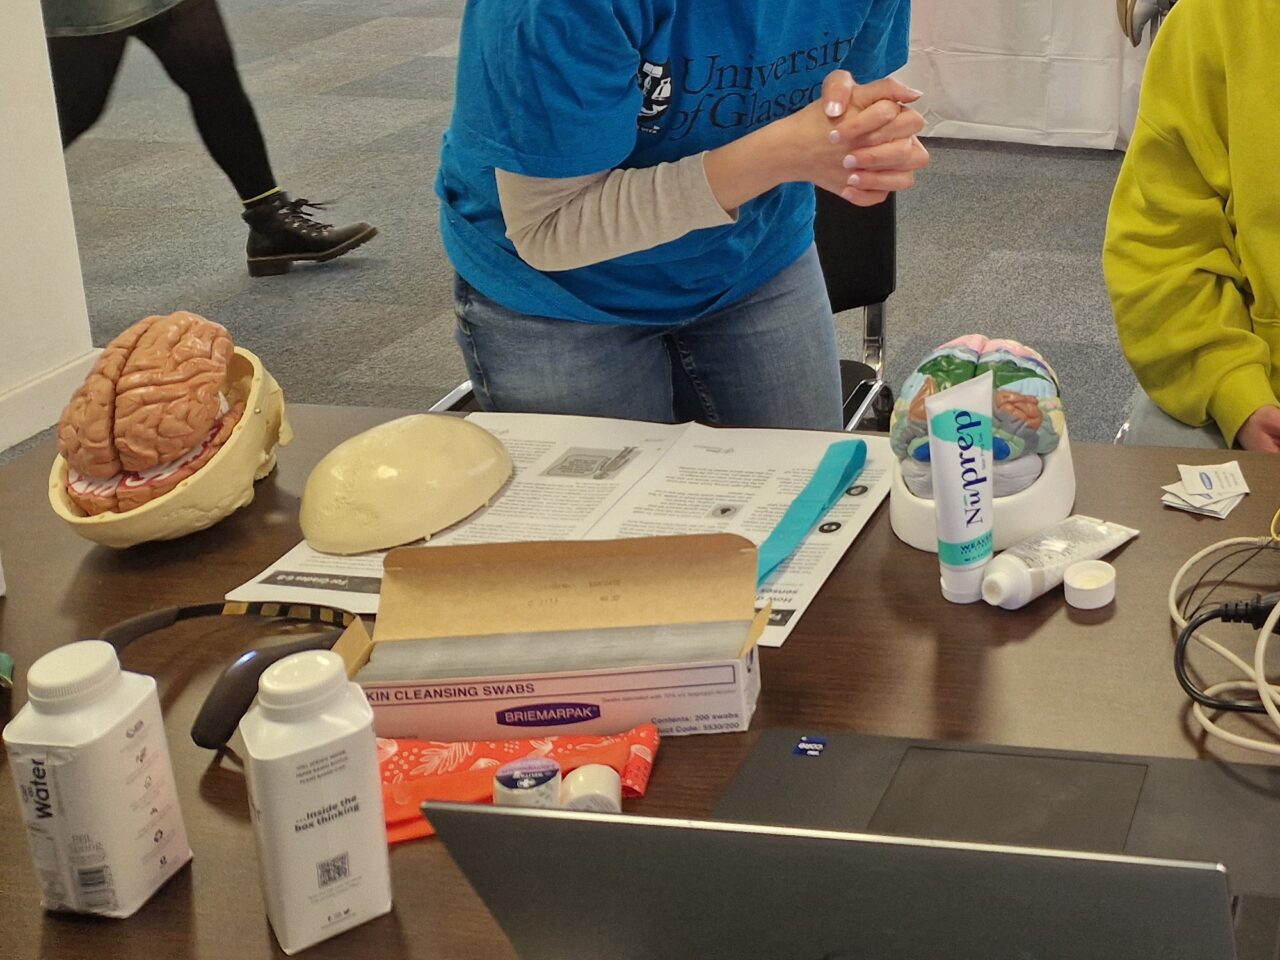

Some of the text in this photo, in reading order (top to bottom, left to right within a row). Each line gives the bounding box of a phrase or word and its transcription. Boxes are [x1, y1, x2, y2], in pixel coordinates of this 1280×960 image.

[681, 32, 852, 95] Universit
[669, 81, 823, 140] of Glasgo
[366, 682, 535, 702] KIN CLEANSING SWABS
[504, 705, 594, 724] BRIEMARPAK
[651, 715, 691, 725] Contents:
[711, 712, 739, 720] swabs
[340, 794, 357, 808] the
[295, 803, 360, 832] box thinking
